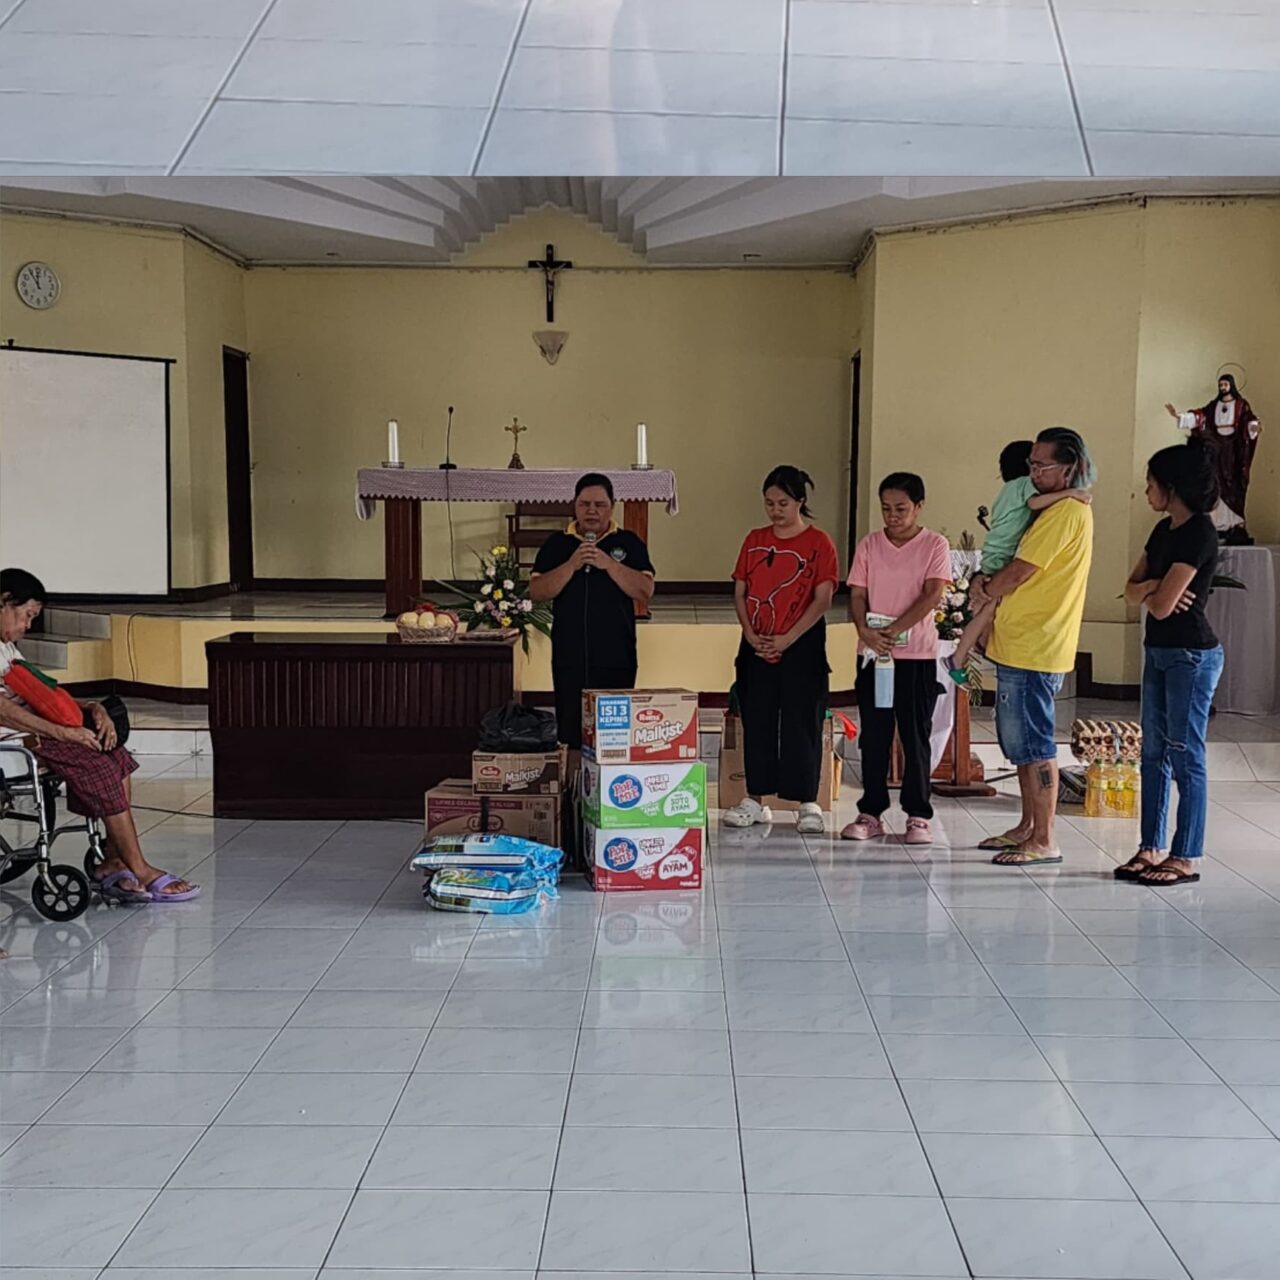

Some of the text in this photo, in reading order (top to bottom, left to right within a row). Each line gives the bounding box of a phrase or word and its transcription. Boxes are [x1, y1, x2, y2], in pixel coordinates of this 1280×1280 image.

[601, 706, 627, 716] ISI 3
[634, 720, 685, 745] Malkist
[505, 767, 541, 784] Malkist
[662, 862, 689, 873] AYAM
